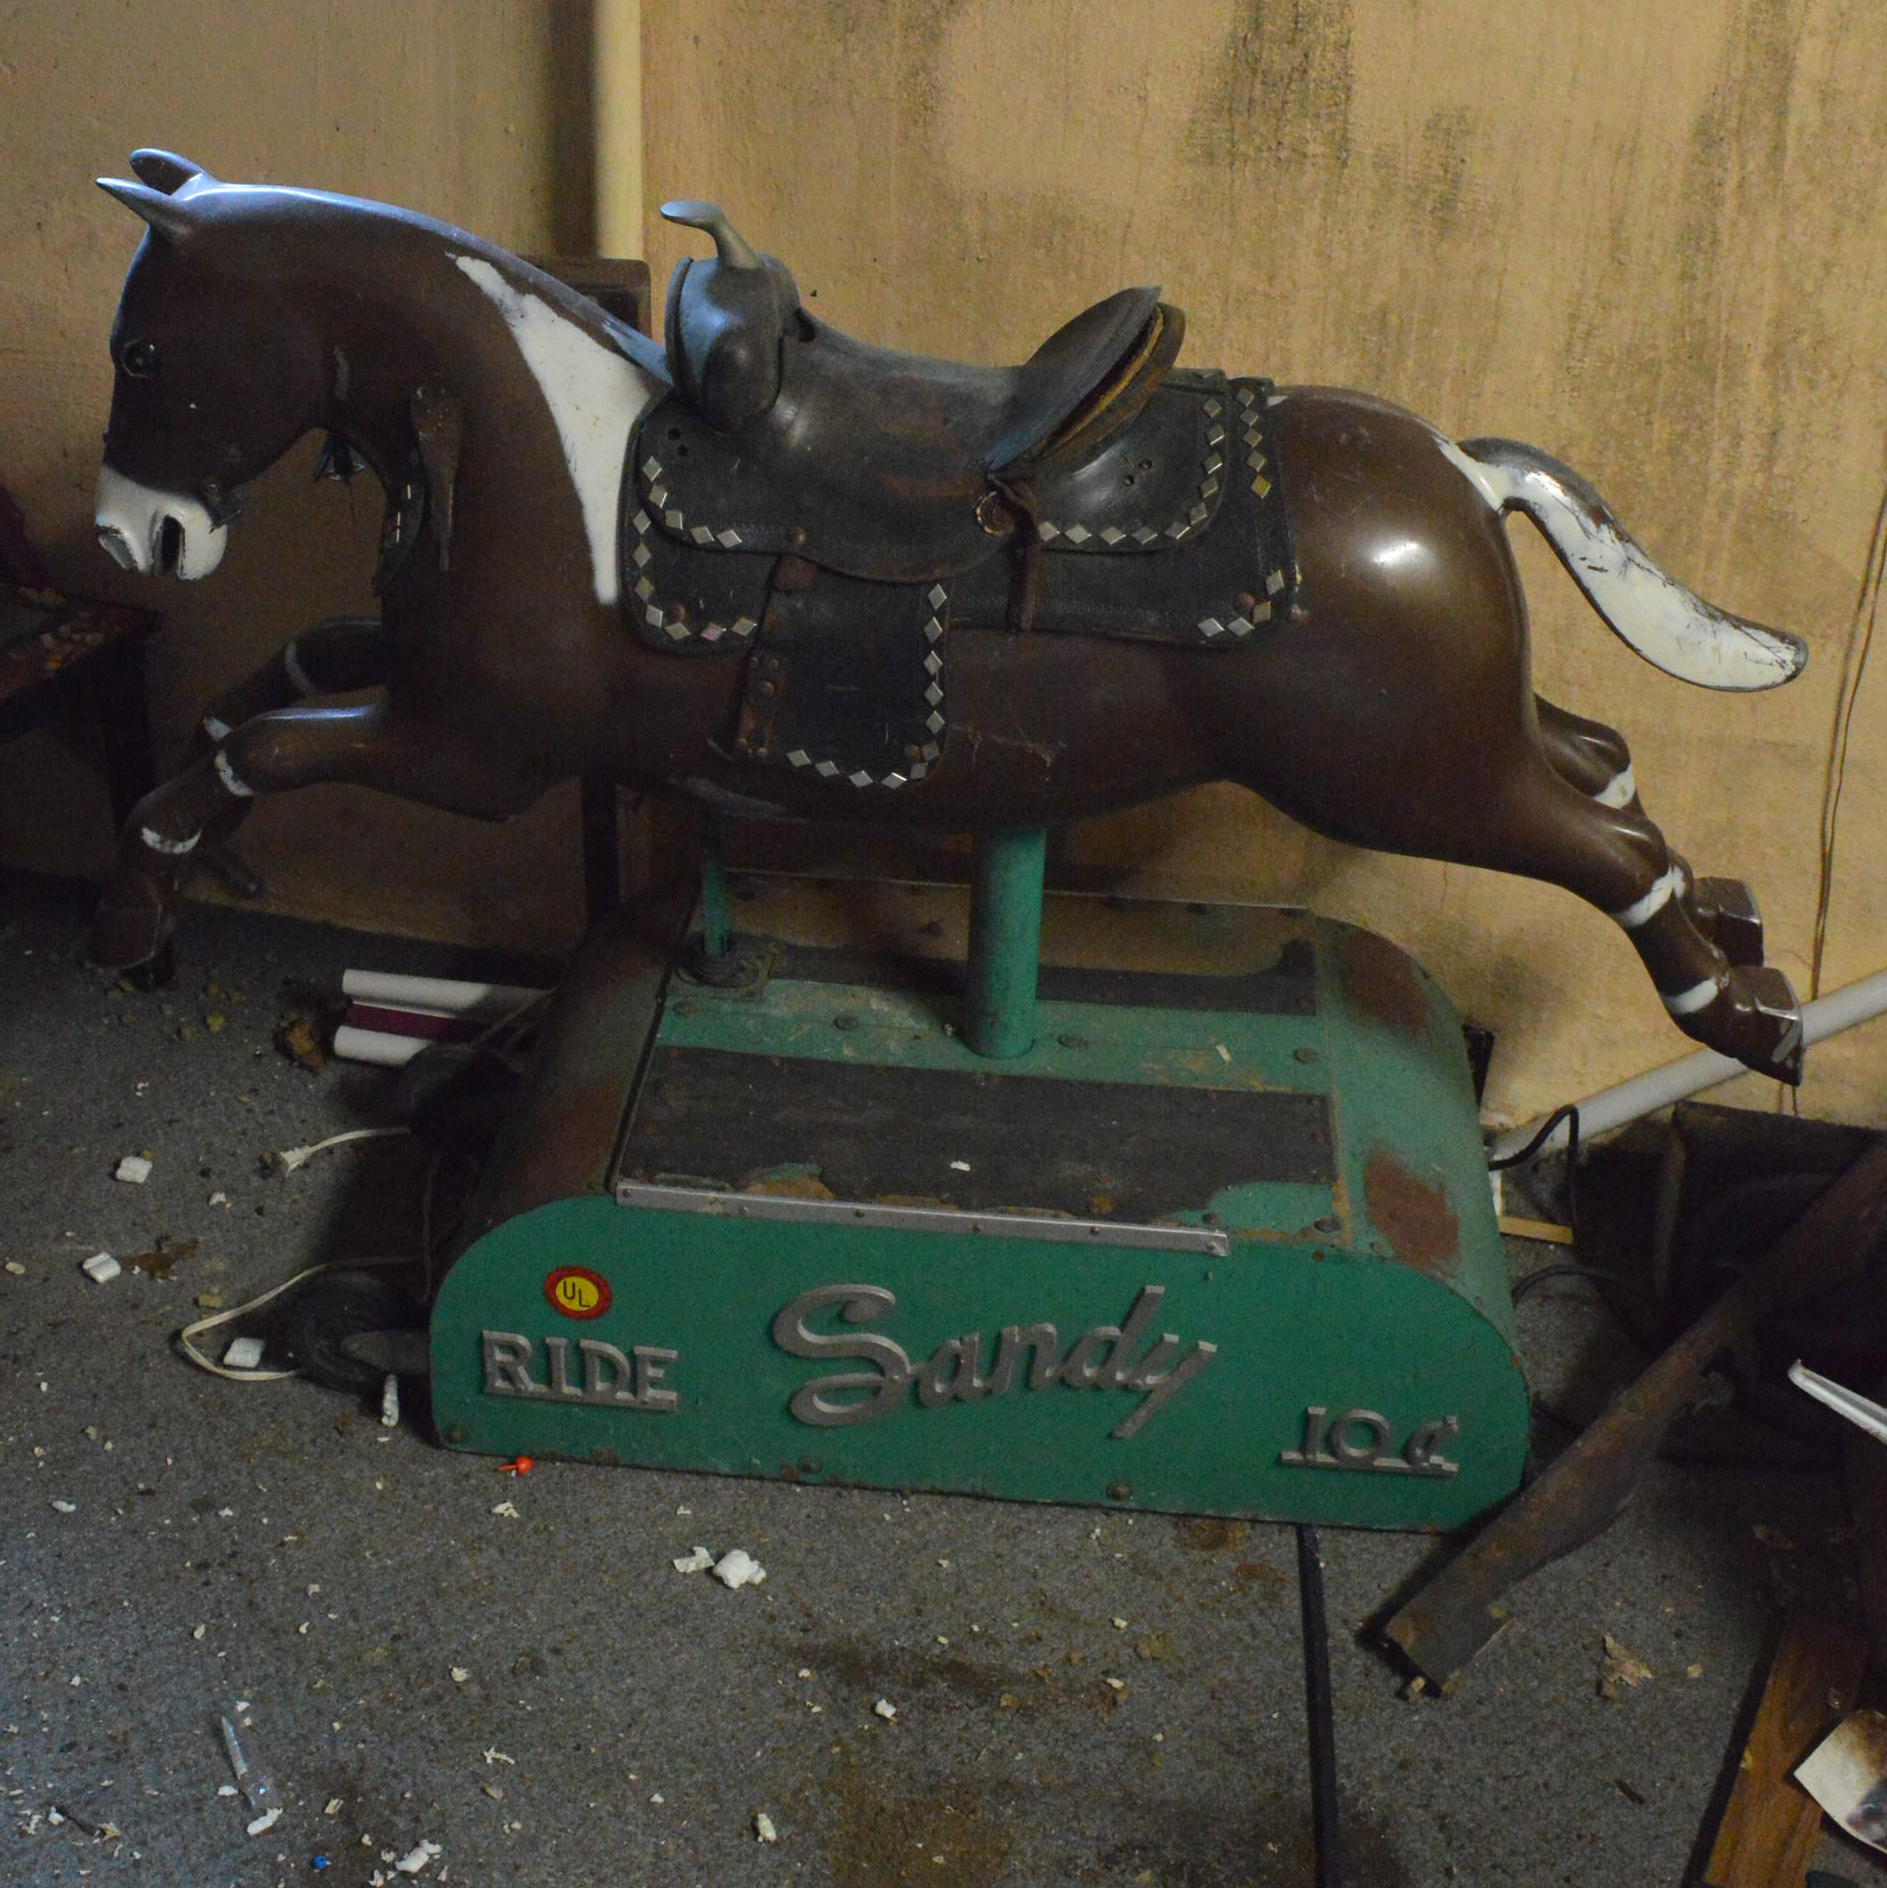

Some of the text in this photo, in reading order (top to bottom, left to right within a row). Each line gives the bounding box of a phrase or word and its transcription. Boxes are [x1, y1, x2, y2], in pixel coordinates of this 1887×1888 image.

[562, 1279, 592, 1308] UL
[482, 1329, 679, 1412] RIDE
[772, 1283, 1218, 1440] Sandy
